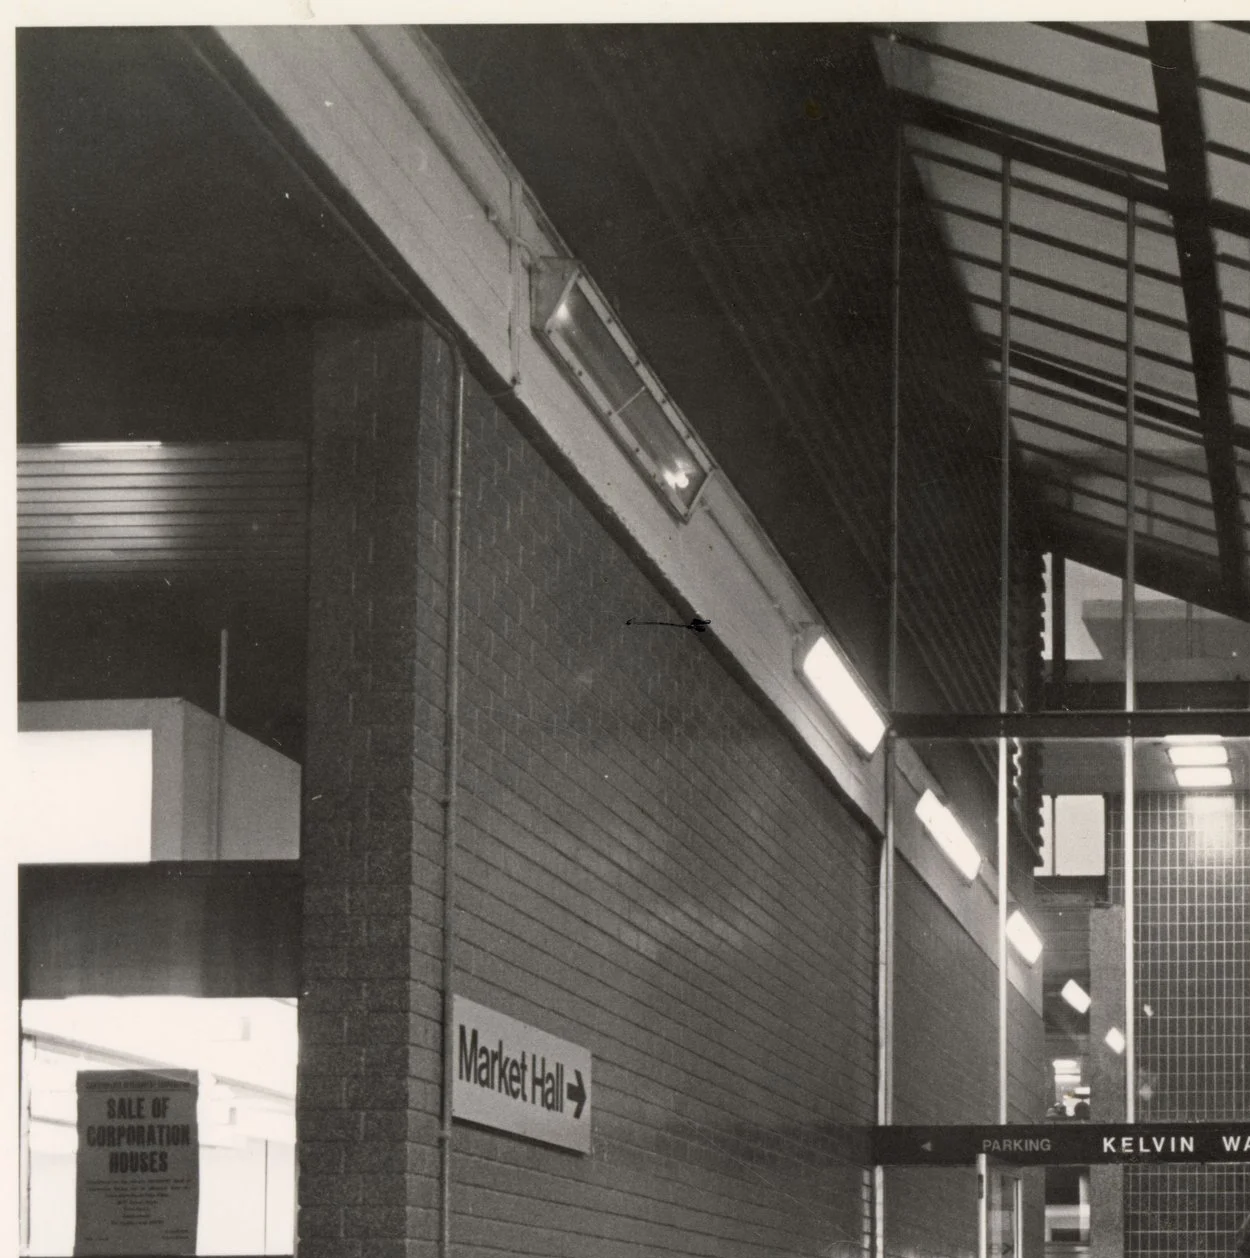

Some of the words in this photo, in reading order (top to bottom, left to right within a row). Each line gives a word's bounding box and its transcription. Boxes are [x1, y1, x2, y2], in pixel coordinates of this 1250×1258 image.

[458, 1023, 528, 1103] Market
[531, 1053, 564, 1113] Hall
[106, 1096, 146, 1120] SALE
[151, 1096, 170, 1119] OF
[86, 1123, 191, 1148] CORPORATION
[981, 1138, 1052, 1152] PARKING
[1102, 1136, 1195, 1153] KELVIN
[108, 1150, 169, 1174] HOUSES
